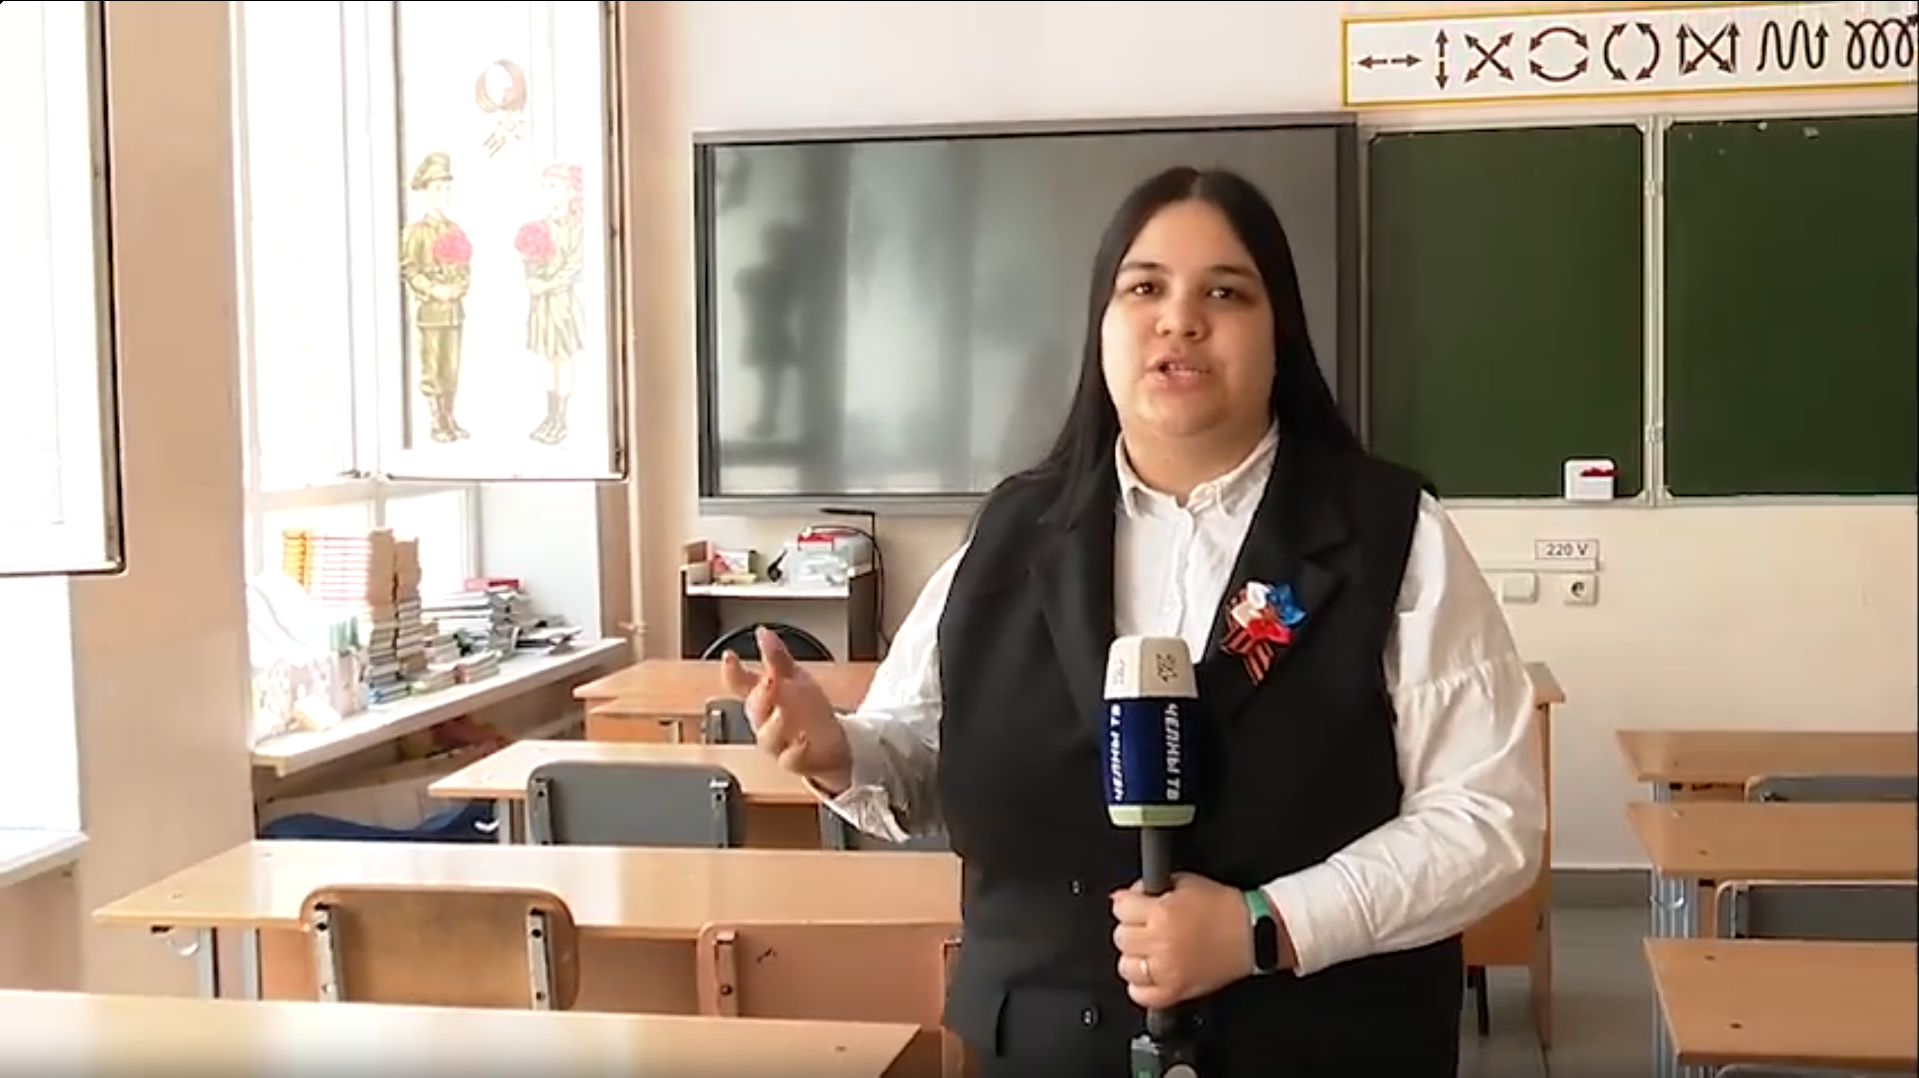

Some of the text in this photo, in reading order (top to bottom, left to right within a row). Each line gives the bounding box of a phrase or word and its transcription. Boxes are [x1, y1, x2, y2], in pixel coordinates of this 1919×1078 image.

[1546, 542, 1588, 556] 220 V
[1110, 703, 1124, 802] ЧЕЛНЫ ТВ
[1164, 703, 1181, 801] ЧЕЛНЫ ТВ
